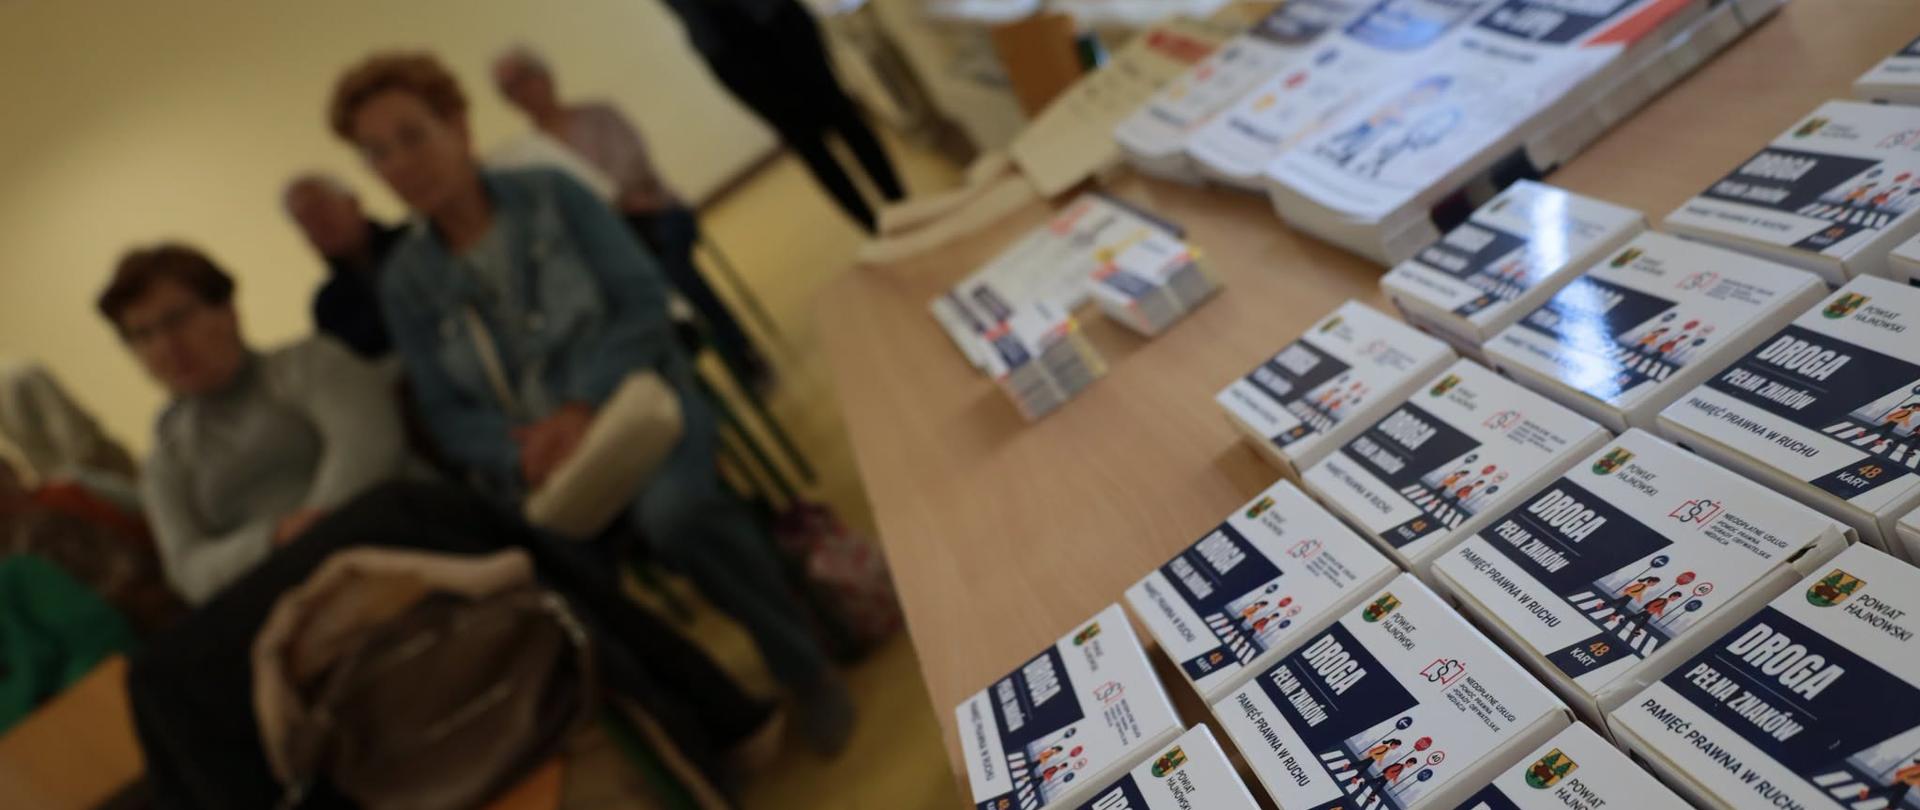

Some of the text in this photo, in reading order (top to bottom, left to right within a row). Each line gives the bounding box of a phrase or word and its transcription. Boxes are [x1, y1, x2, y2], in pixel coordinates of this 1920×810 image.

[1755, 333, 1852, 382] DROGA
[1721, 367, 1817, 412] PEŁNA ZNAKÓW
[1686, 397, 1820, 459] PAMIĘĆ PRAWNA W RUCHU
[1836, 470, 1870, 491] KART
[1858, 464, 1883, 479] 48
[1527, 488, 1607, 543] DROGA
[1494, 519, 1570, 574] PEŁNA ZNAKÓW
[1459, 547, 1562, 629] PAMIĘĆ PRAWNA W RUCHU
[1856, 593, 1906, 622] POWIAT
[1381, 620, 1416, 651] HAJNOWSKI
[1390, 612, 1417, 634] POWIAT
[1843, 604, 1914, 642] HAJNOWSKI
[1301, 633, 1367, 696] DROGA
[1570, 647, 1596, 667] KART
[1588, 641, 1611, 658] 48
[1725, 621, 1846, 701] DROGA
[1269, 664, 1329, 728] PEŁNA ZNAKÓW
[1683, 661, 1805, 742] PEŁNA ZNAKÓW
[1235, 692, 1311, 787] PAMIĘĆ PRAWNA W RUCHU
[1640, 697, 1806, 810] PAMIĘĆ PRAWNA W RUCH
[1566, 777, 1606, 809] POWIAT
